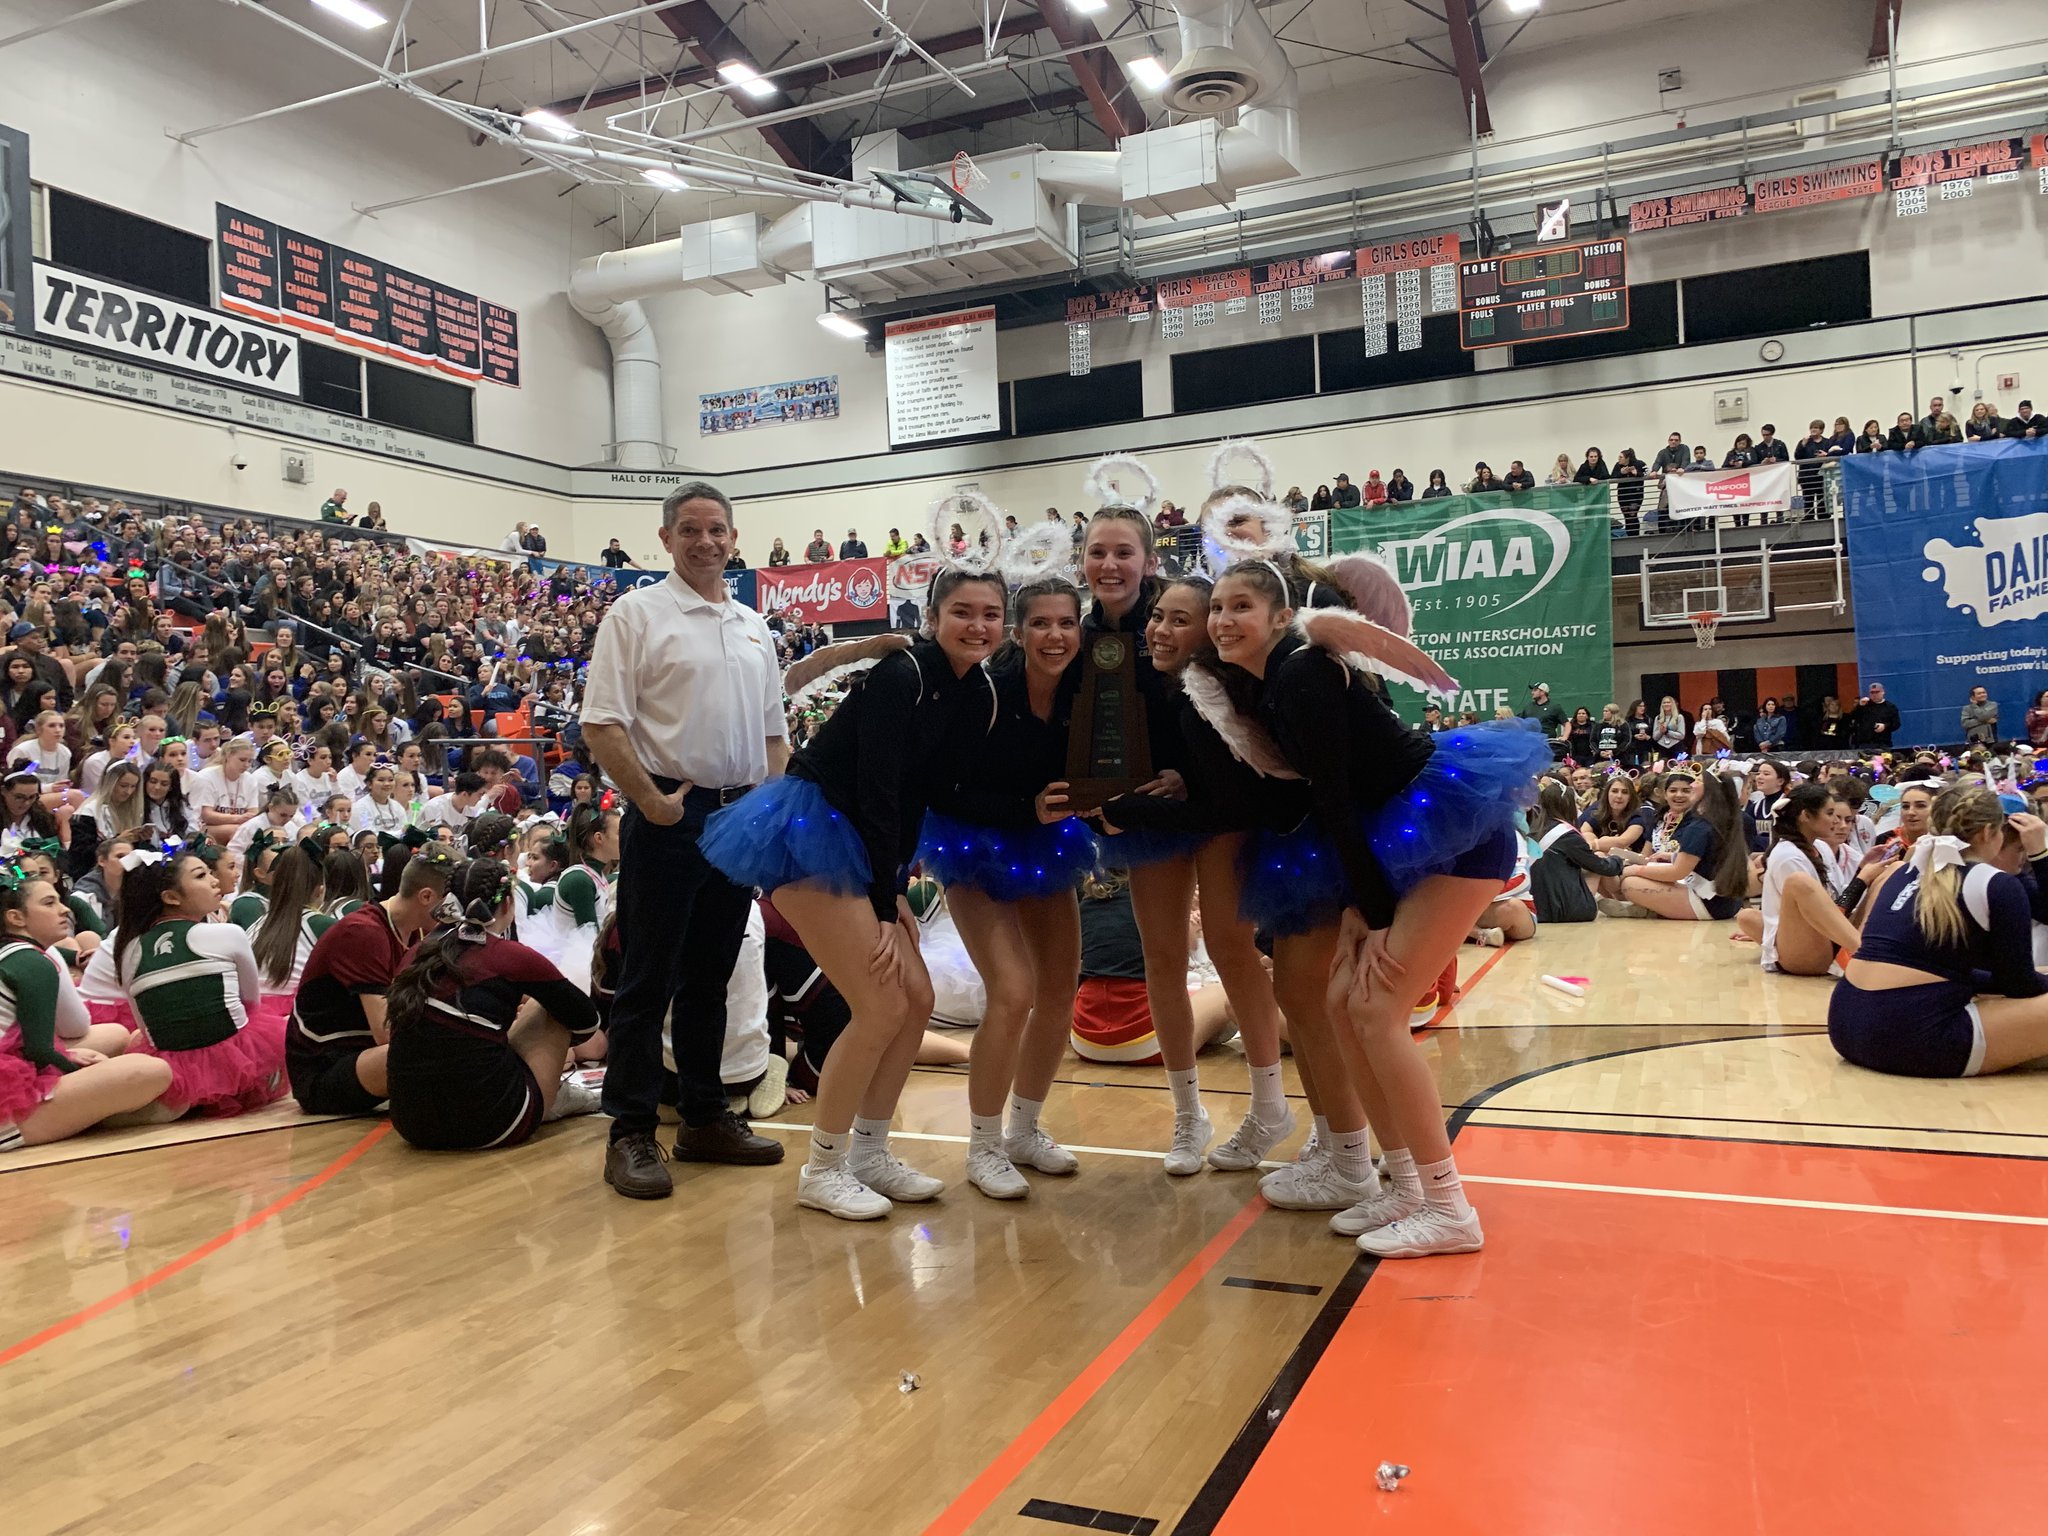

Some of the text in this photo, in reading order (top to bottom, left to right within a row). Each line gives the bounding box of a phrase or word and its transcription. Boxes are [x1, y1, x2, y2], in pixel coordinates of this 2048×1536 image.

[1901, 150, 1945, 177] BOYS
[1949, 139, 2012, 167] TENNIS
[1757, 163, 1878, 200] GIRLS SWIMMING
[1943, 180, 1971, 190] 1976
[1758, 199, 1792, 211] LEAGUE
[1847, 184, 1874, 197] STATE
[1898, 187, 1926, 198] 1975
[1943, 189, 1972, 200] 2003
[1631, 186, 1746, 220] BOYS SWIMMING
[1898, 196, 1926, 207] 2004
[1899, 205, 1928, 217] 2005
[1371, 236, 1443, 265] GIRLS GOLF
[1584, 241, 1622, 257] VISITOR
[236, 251, 261, 269] STATE
[1268, 260, 1300, 281] BOYS
[1463, 261, 1497, 275] HOME
[294, 270, 318, 287] STATE
[1324, 270, 1346, 281] STATE
[1363, 275, 1384, 284] 1990
[1397, 270, 1419, 279] 1990
[1160, 270, 1246, 299] GIRLS TRACK &
[1206, 279, 1238, 292] FIELD
[1397, 278, 1419, 286] 1991
[1584, 279, 1611, 290] BONUS
[1292, 286, 1312, 295] 1979
[1364, 283, 1384, 292] 1991
[1398, 286, 1419, 295] 1996
[1225, 288, 1246, 299] STATE
[1260, 291, 1280, 301] 1990
[1292, 294, 1312, 303] 1999
[1364, 291, 1385, 300] 1992
[1398, 294, 1419, 303] 1997
[1521, 288, 1546, 299] PERIOD
[1592, 291, 1618, 302] FOULS
[1067, 294, 1097, 315] BOYS
[1100, 288, 1137, 302] TRACK
[1109, 296, 1140, 308] FIELD
[1260, 299, 1280, 309] 1997
[1293, 301, 1314, 311] 2002
[1364, 300, 1385, 309] 1996
[1399, 301, 1420, 310] 1998
[1475, 295, 1501, 307] BONUS
[1517, 297, 1575, 313] PLAYER FOULS
[1194, 303, 1214, 311] 1975
[1260, 307, 1280, 316] 1999
[1163, 308, 1183, 317] 1976
[1194, 310, 1214, 319] 1990
[1365, 308, 1385, 317] 1997
[1399, 309, 1420, 318] 2000
[1470, 309, 1494, 320] FOULS
[1163, 315, 1183, 324] 1978
[1194, 317, 1214, 327] 2009
[1261, 315, 1281, 324] 2000
[1365, 316, 1385, 325] 1998
[1399, 317, 1420, 327] 2001
[43, 275, 292, 382] TERRITORY
[1164, 323, 1183, 331] 1990
[1366, 323, 1386, 333] 2000
[1399, 325, 1421, 334] 2002
[1164, 330, 1184, 339] 2009
[1366, 332, 1386, 341] 2002
[1400, 333, 1421, 343] 2003
[1366, 340, 1387, 349] 2003
[1071, 353, 1089, 361] 1947
[1072, 360, 1089, 369] 1983
[1072, 368, 1089, 376] 1987
[611, 473, 681, 484] HALL OF FAME
[1708, 482, 1749, 493] FANFOOD
[1675, 506, 1702, 514] SHORTER
[1292, 515, 1316, 523] STARTS
[1377, 536, 1537, 592] WIAA
[761, 572, 842, 612] Wendy's
[1456, 624, 1597, 645] INTERSCHOLASTIC
[1463, 643, 1564, 660] ASSOCIATION
[1936, 646, 2047, 666] Supporting today's
[1975, 661, 2041, 675] tomorrow's
[1424, 688, 1510, 713] STATE
